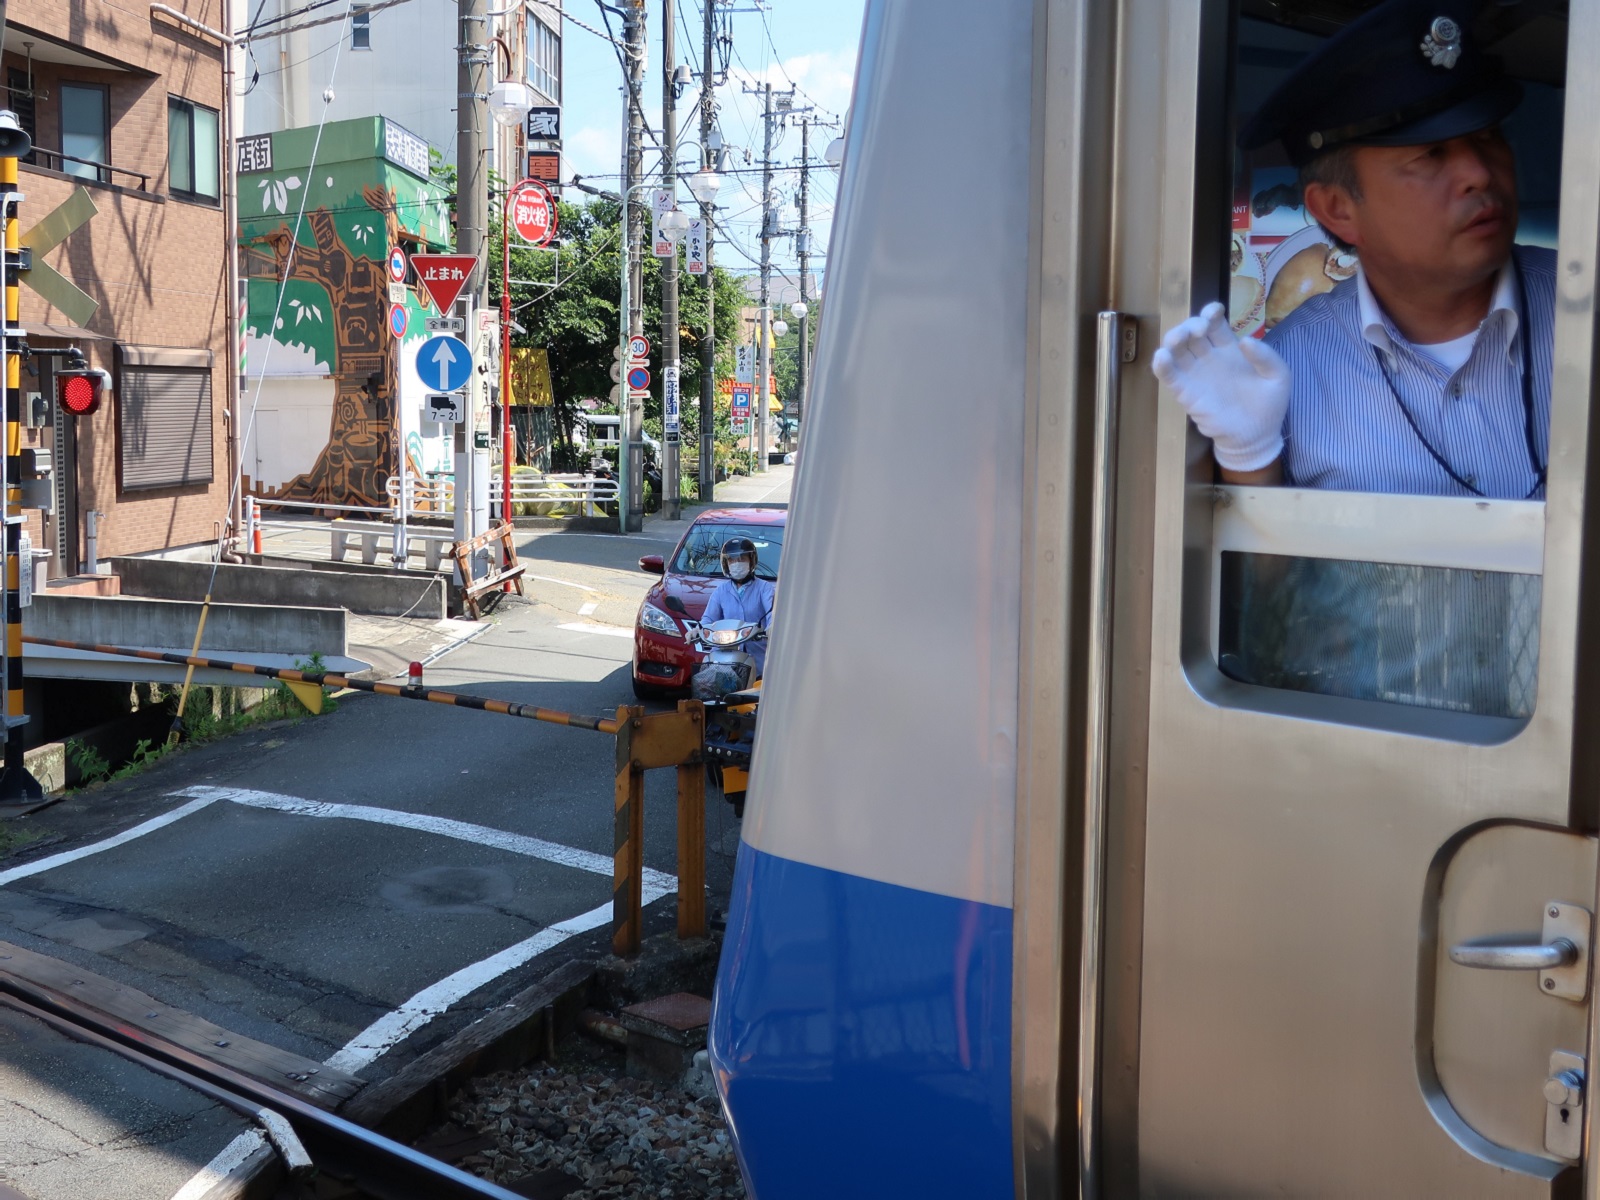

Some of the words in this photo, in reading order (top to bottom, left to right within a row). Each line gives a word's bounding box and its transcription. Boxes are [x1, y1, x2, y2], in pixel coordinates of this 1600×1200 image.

[517, 205, 546, 227] 消火栓
[692, 238, 700, 261] かのや
[424, 267, 464, 280] 止まれ
[429, 320, 460, 329] 全車両
[632, 342, 644, 352] 30
[736, 395, 746, 405] P
[432, 412, 458, 420] 7-21
